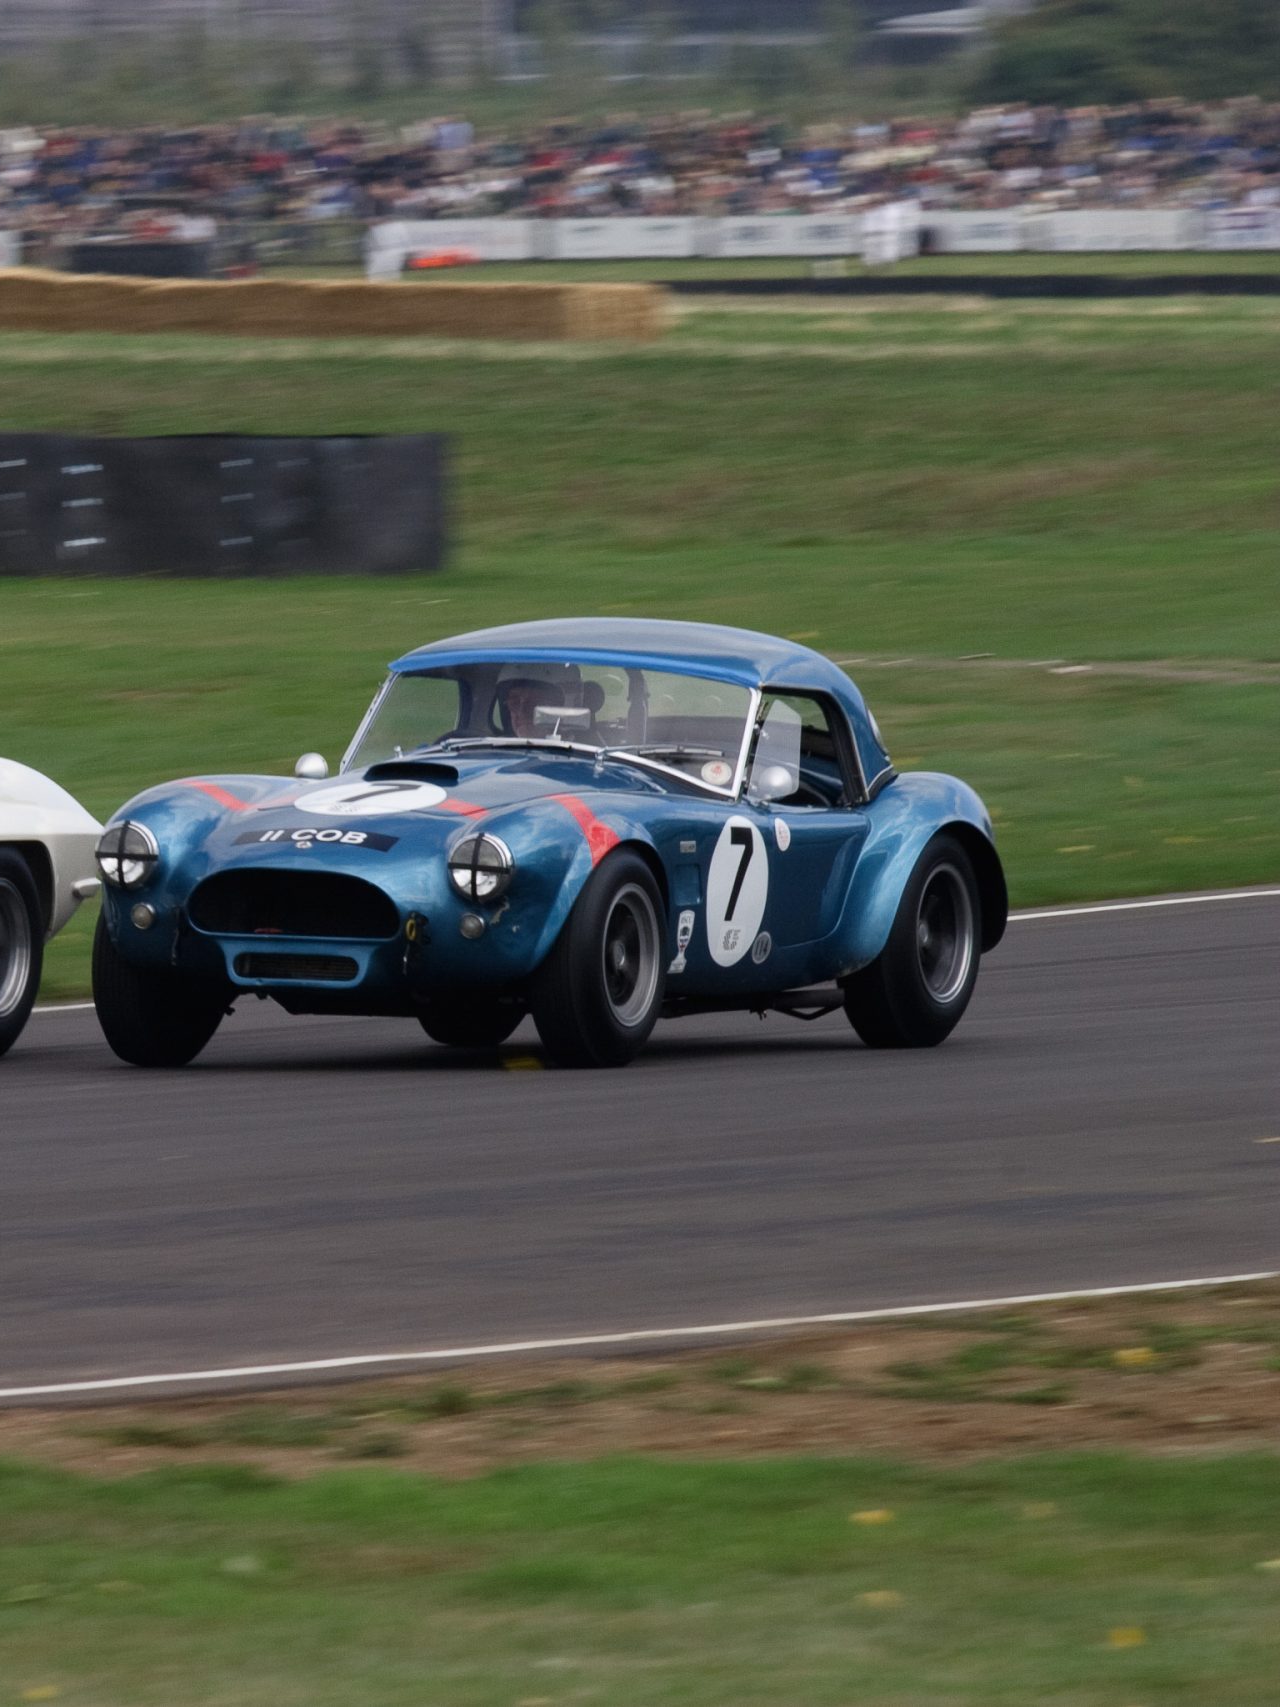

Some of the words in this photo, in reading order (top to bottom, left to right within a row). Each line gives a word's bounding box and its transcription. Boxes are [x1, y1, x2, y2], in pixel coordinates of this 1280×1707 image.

[339, 783, 422, 803] 7
[291, 828, 368, 845] COB
[723, 826, 754, 921] 7
